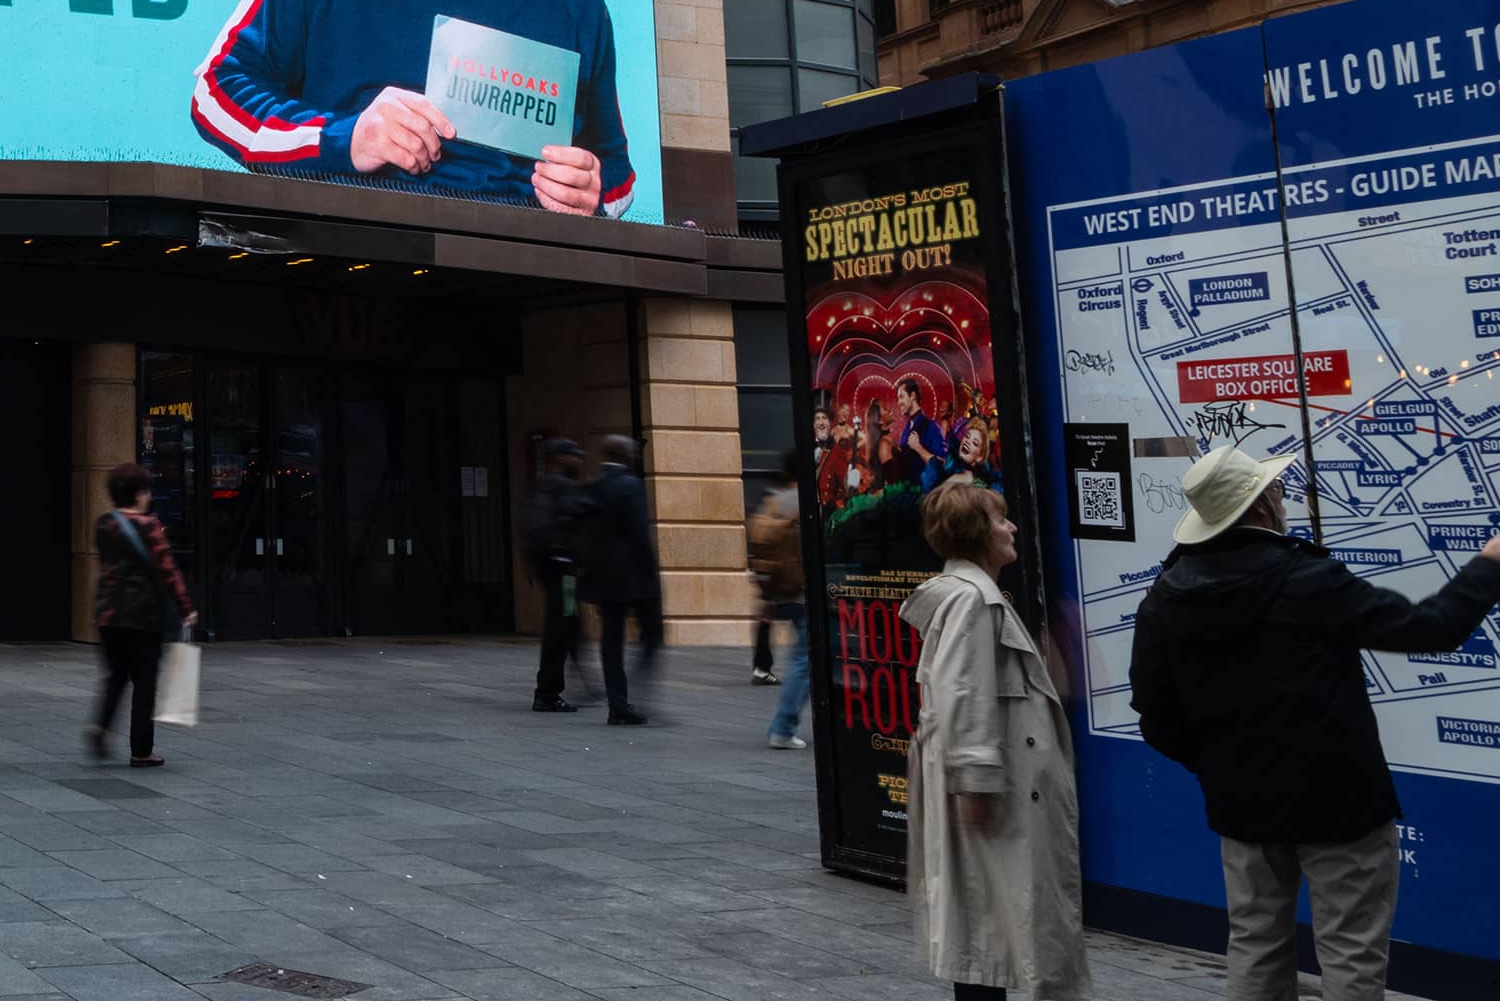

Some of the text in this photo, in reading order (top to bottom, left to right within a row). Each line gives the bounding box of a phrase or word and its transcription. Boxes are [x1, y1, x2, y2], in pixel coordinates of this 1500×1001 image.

[449, 55, 560, 98] HOLLYOAKS
[1265, 36, 1446, 110] WELCOME
[446, 74, 558, 127] UNWRAPPED
[1414, 80, 1500, 109] THE HO
[809, 181, 970, 222] LONDON'S MOST
[1084, 207, 1143, 236] WEST
[1148, 199, 1197, 229] END
[1200, 179, 1330, 218] THEATRES
[1350, 161, 1438, 197] GUIDE
[805, 197, 981, 262] SPECTACULAR
[1442, 229, 1500, 245] Totten
[1146, 251, 1186, 266] Oxford
[1445, 242, 1498, 260] Court
[833, 253, 896, 281] NIGHT
[1077, 284, 1123, 299] Oxford
[1203, 278, 1253, 291] LONDON
[1194, 287, 1264, 304] PALLADIUM
[1078, 299, 1122, 312] Circus
[1187, 356, 1334, 381] LEICESTER SQUARE
[1215, 378, 1247, 397] BOX
[1375, 402, 1436, 416] GIELGUD
[1360, 421, 1415, 434] APOLLO
[1360, 473, 1400, 486] LYRIC
[1430, 526, 1486, 538] PRINCE
[1444, 539, 1487, 551] WALE
[837, 598, 921, 668] MOU
[1417, 671, 1448, 686] Pall
[843, 662, 923, 735] ROU
[1443, 731, 1494, 746] APOLLO
